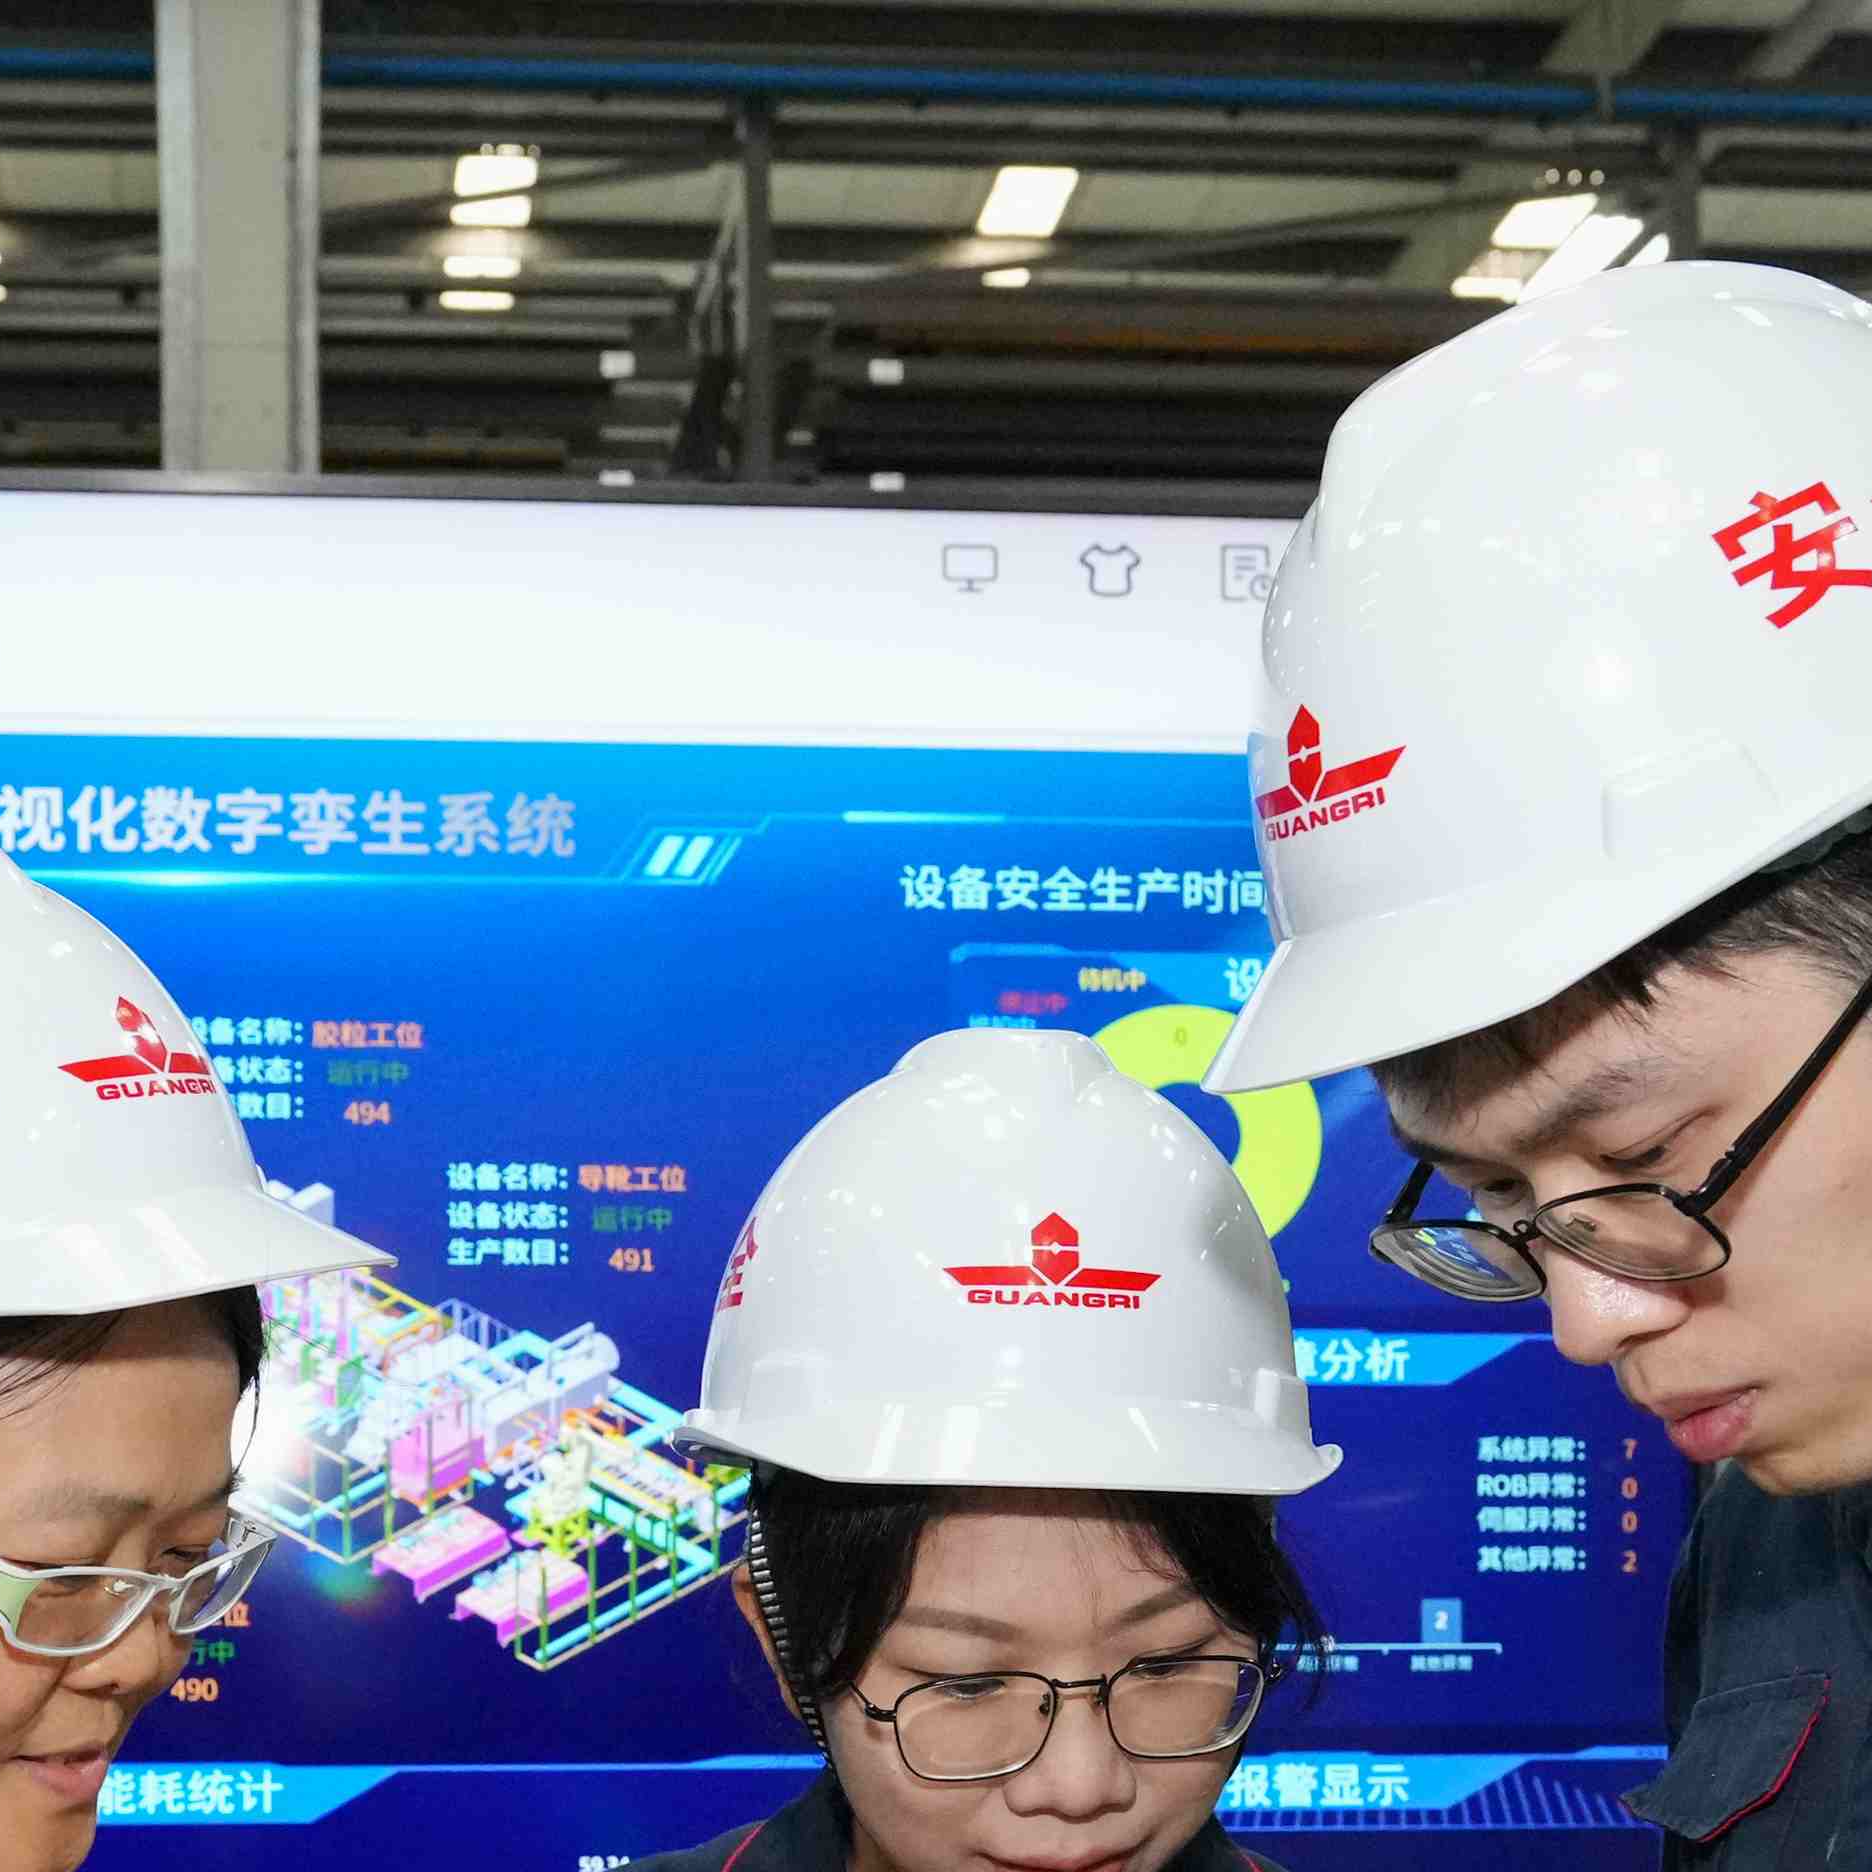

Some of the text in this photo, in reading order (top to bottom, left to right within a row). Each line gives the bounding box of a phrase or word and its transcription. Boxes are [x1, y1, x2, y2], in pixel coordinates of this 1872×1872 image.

[1266, 786, 1386, 841] GUANGRI
[96, 1078, 217, 1101] GUANGRI
[344, 1101, 391, 1125] 494
[592, 1207, 672, 1231] 运行中
[608, 1248, 655, 1272] 491
[967, 1289, 1141, 1309] GUANGRI
[1623, 1438, 1638, 1460] 7
[1621, 1477, 1638, 1499] 0
[1621, 1511, 1638, 1533] 0
[1622, 1550, 1638, 1573] 2
[1434, 1610, 1449, 1632] 2
[170, 1678, 219, 1701] 490
[97, 1769, 284, 1815] 能耗统计
[1227, 1764, 1410, 1807] 报警显示
